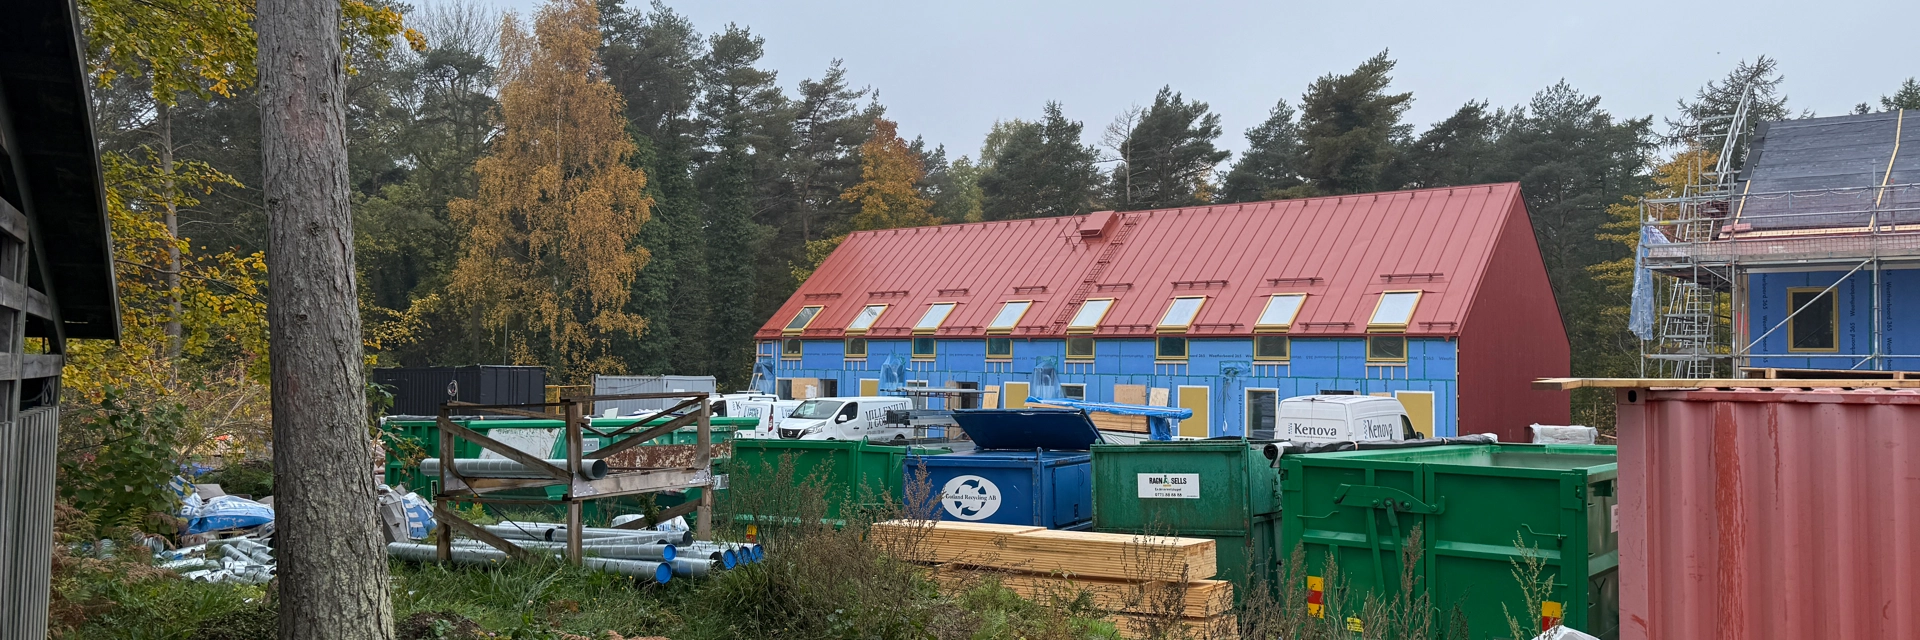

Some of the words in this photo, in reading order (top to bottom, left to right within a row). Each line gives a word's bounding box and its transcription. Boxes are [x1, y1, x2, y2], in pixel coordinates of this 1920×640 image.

[1294, 423, 1337, 436] Kenova
[1366, 419, 1393, 439] Kenova
[1170, 477, 1187, 485] SELLS
